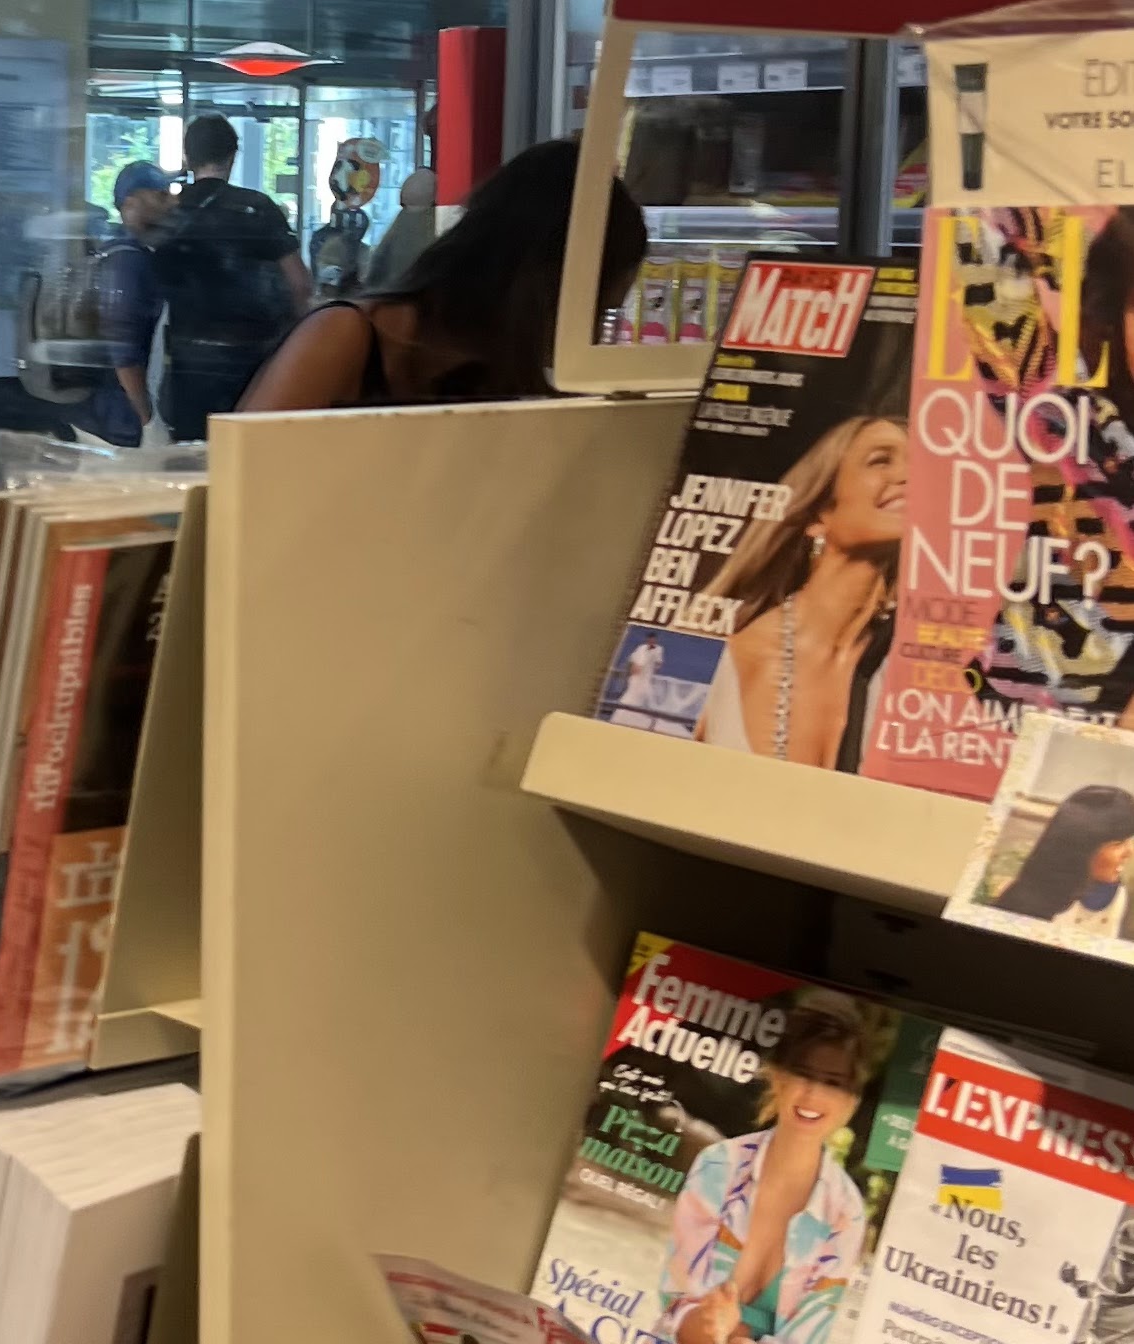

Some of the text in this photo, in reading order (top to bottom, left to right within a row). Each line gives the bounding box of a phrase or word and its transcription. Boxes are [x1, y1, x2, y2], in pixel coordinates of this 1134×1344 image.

[724, 265, 868, 352] MATCH
[917, 387, 1091, 465] QUOI
[669, 473, 793, 522] JENNIFER
[950, 459, 1030, 531] DE
[655, 510, 746, 556] LOPEZ
[643, 545, 701, 588] BEN
[907, 526, 1112, 610] NEUF?
[628, 584, 745, 635] AFFLECK
[631, 952, 788, 1048] Femme
[616, 1005, 762, 1085] Actuelle
[577, 1136, 687, 1194] maison
[943, 1193, 1027, 1248] Nous,
[953, 1233, 1000, 1271] les
[546, 1256, 644, 1321] Spécial
